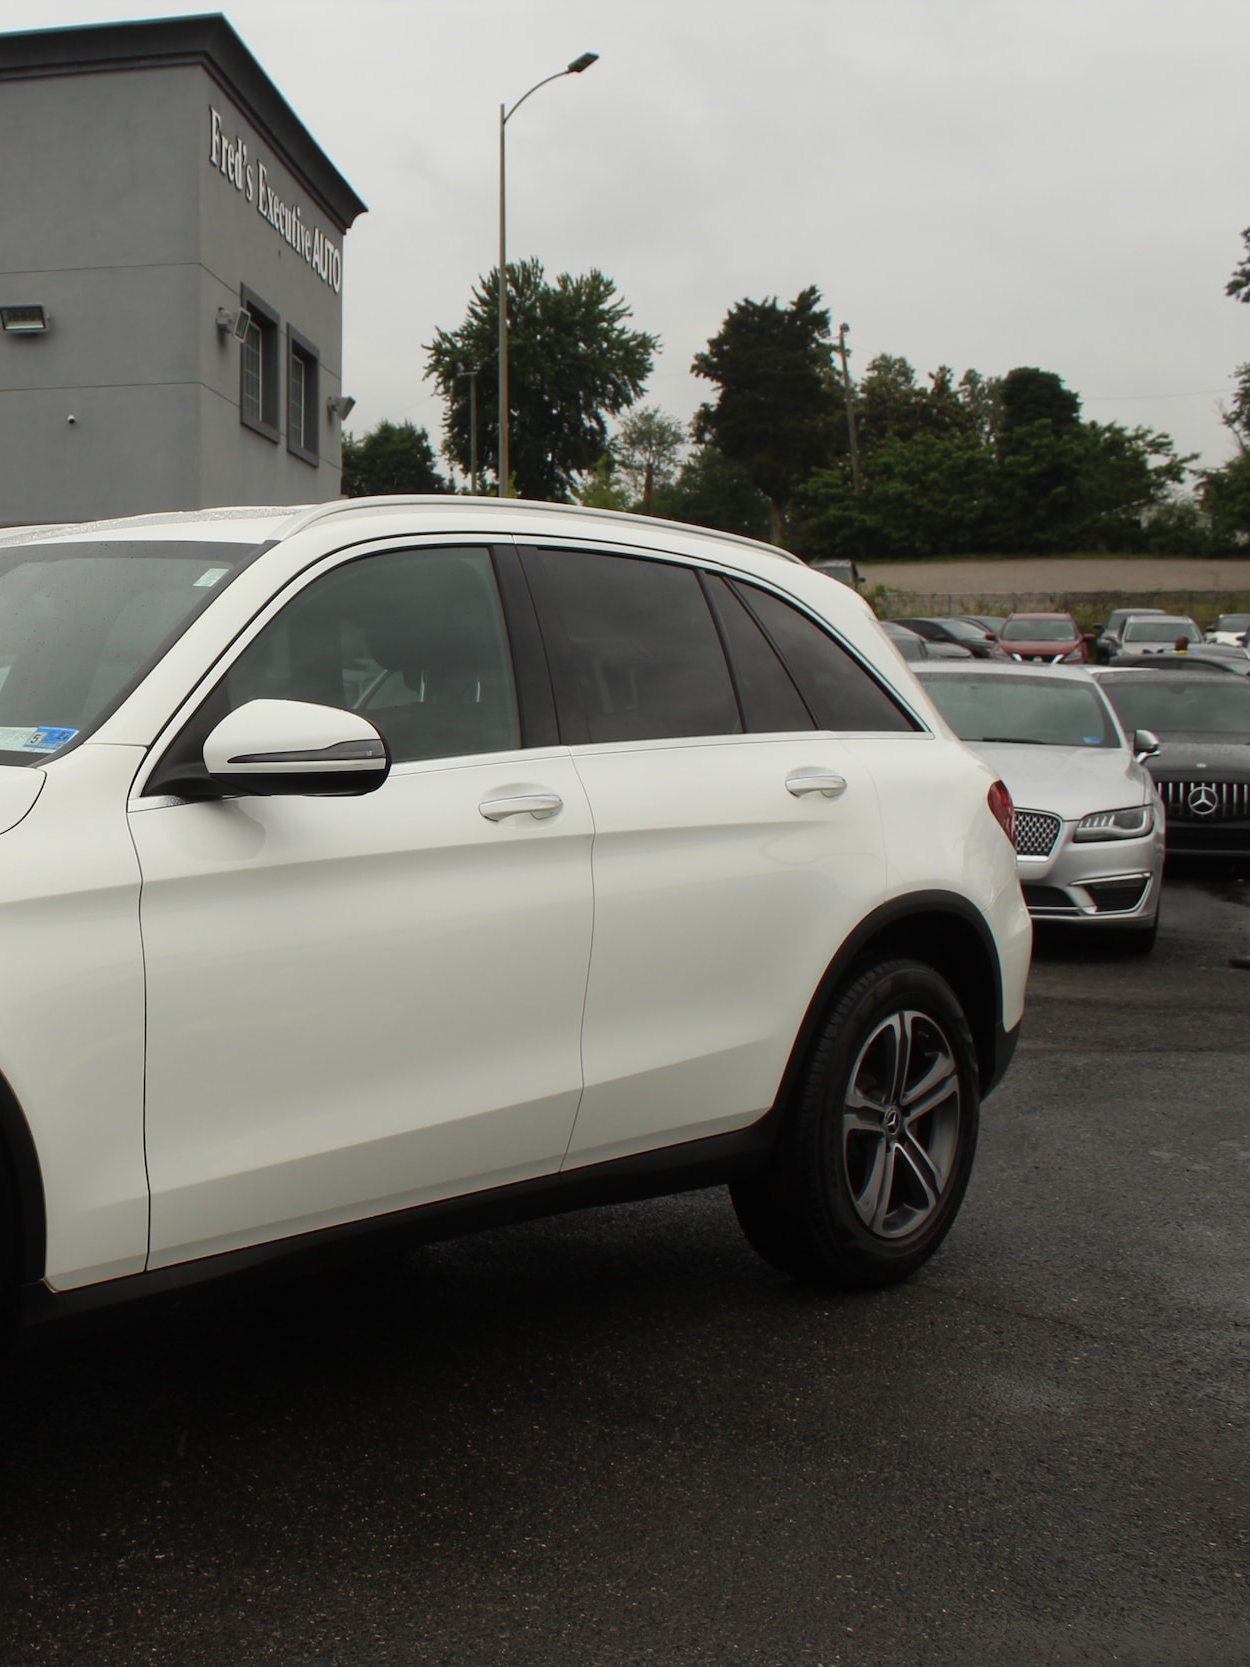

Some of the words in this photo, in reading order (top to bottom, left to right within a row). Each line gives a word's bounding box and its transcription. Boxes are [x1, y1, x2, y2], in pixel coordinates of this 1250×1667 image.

[210, 106, 253, 201] Fred's
[257, 160, 310, 262] Executive
[312, 228, 341, 293] AUTO
